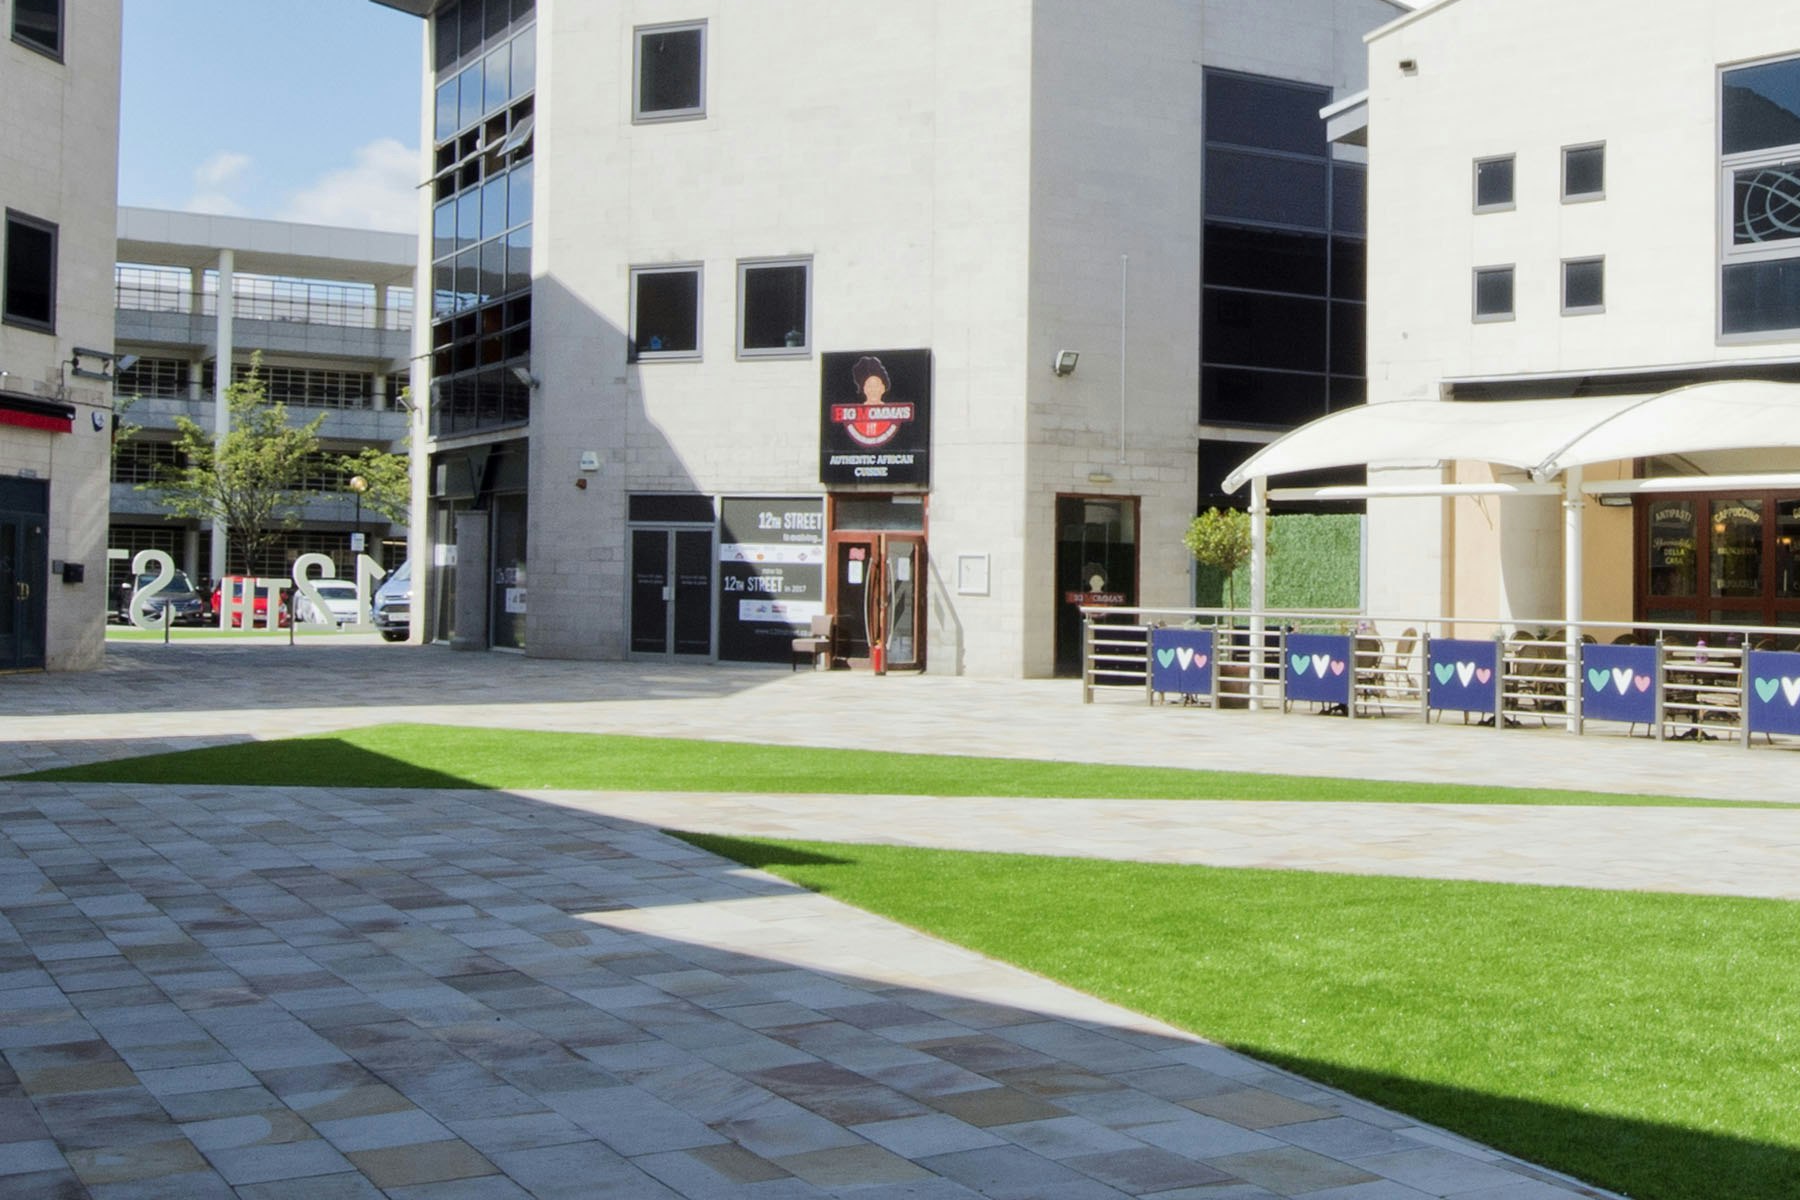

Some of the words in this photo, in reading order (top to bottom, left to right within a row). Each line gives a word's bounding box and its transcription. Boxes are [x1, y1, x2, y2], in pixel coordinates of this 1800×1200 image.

[835, 407, 857, 421] BIG
[830, 455, 876, 465] AUTHENTIC
[877, 454, 914, 465] AFRICAN
[854, 466, 888, 477] CUISINE
[758, 512, 781, 529] 12TH
[784, 513, 823, 530] STREET
[1714, 507, 1760, 522] CAPPUCCINO
[724, 576, 744, 591] 12TH
[747, 577, 784, 592] STREET
